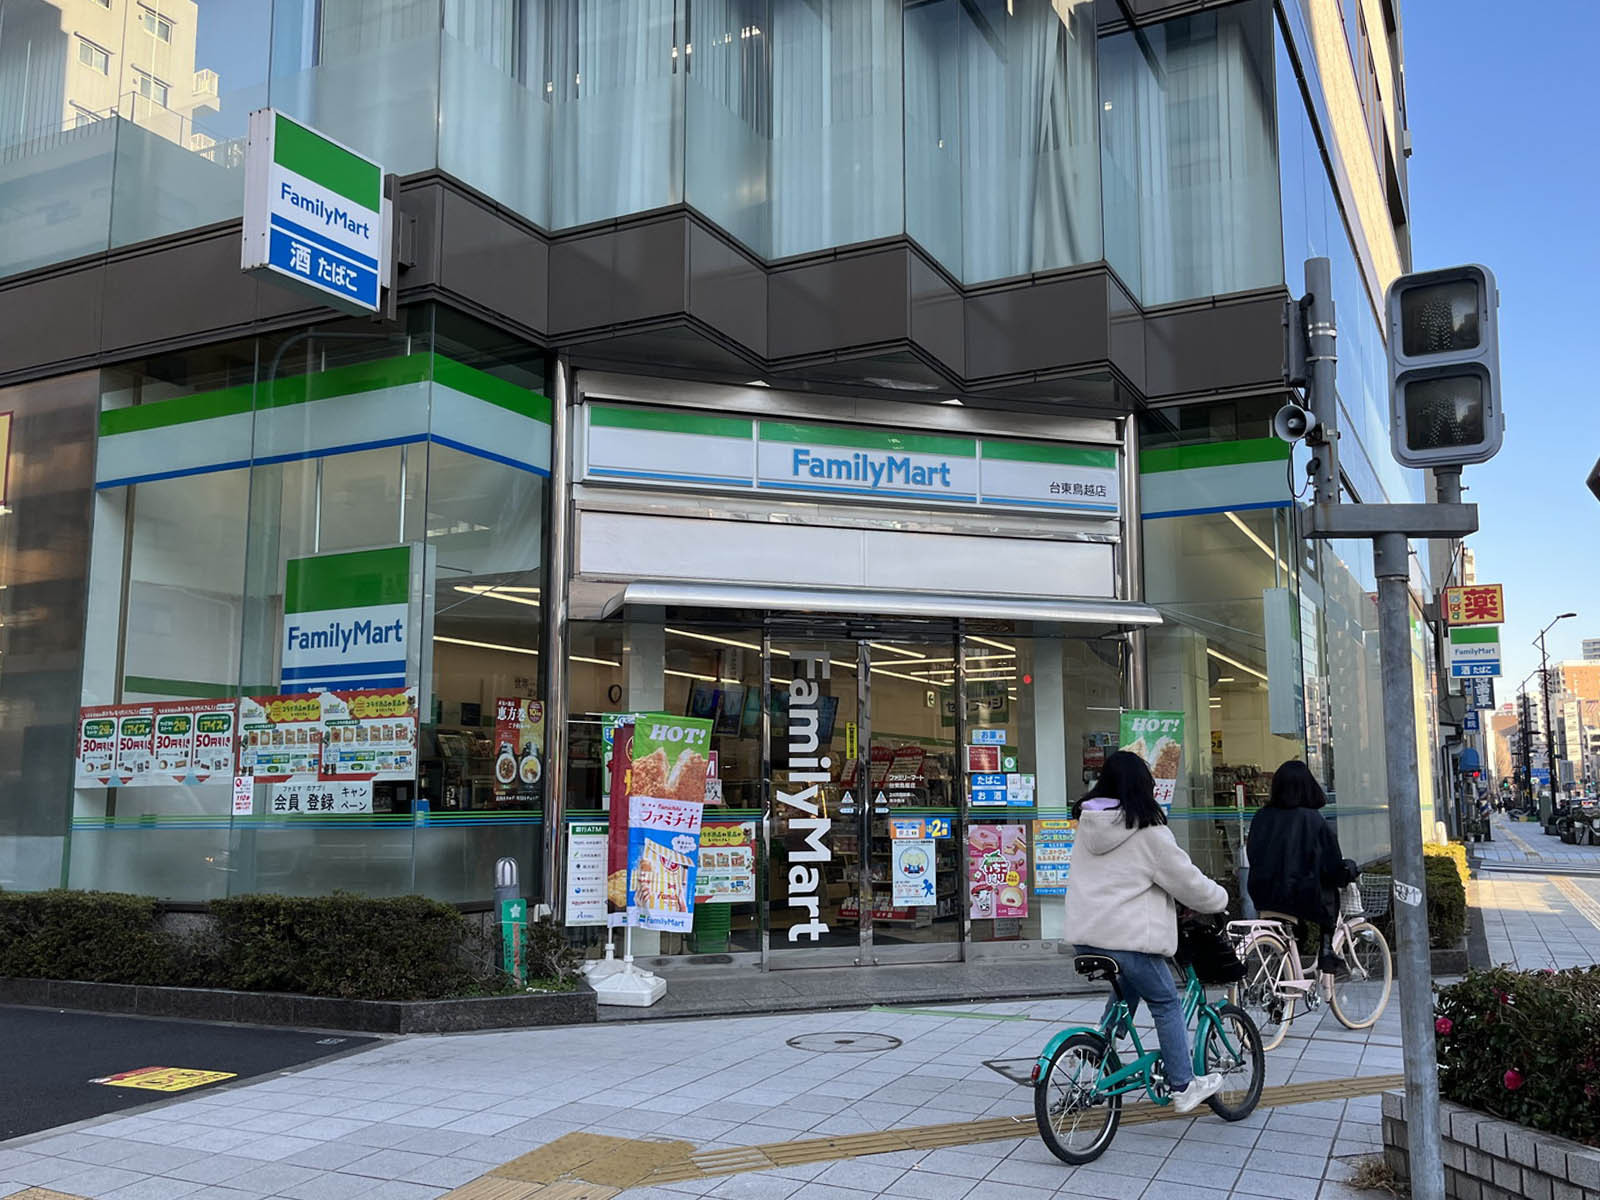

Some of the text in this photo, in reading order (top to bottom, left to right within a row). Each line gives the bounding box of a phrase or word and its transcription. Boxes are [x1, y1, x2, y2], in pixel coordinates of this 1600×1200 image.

[281, 182, 369, 239] FamilyMart
[289, 241, 358, 292] 酒 たばこ
[793, 448, 951, 489] FamilyMart
[1049, 481, 1107, 498] 台東鳥越店
[1464, 588, 1499, 620] 薬
[288, 619, 403, 653] FamilyMart
[1455, 647, 1496, 656] FamilyMart
[649, 724, 706, 744] HOT!
[1132, 717, 1180, 732] HOT!
[977, 776, 1001, 785] たばこ
[274, 793, 335, 811] 会員 登録
[341, 787, 368, 798] キャン
[776, 651, 832, 942] FamilyMart
[640, 810, 698, 829] ファミチキ
[647, 915, 685, 927] FamilyMart
